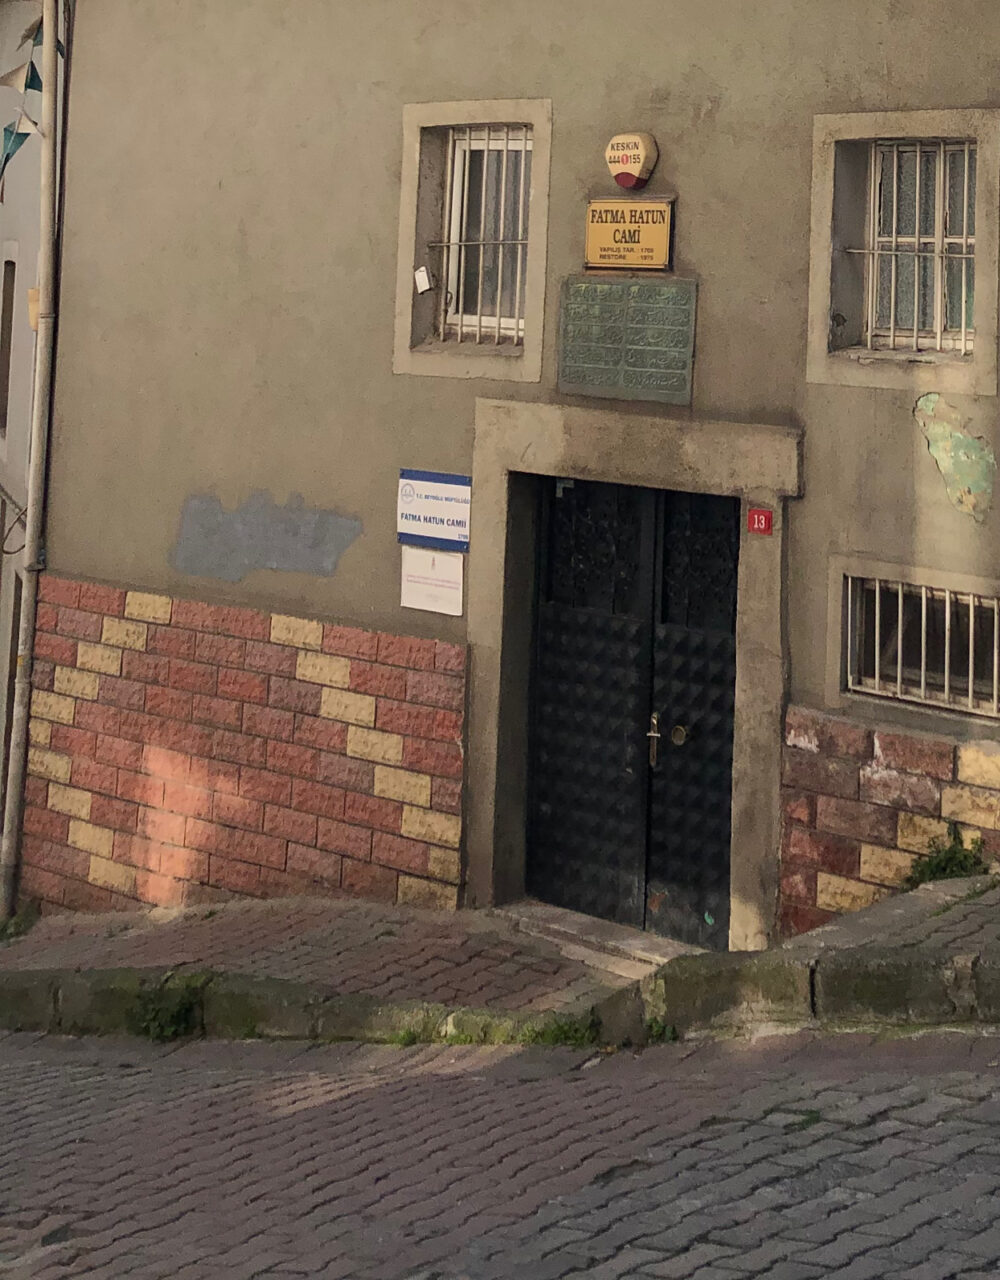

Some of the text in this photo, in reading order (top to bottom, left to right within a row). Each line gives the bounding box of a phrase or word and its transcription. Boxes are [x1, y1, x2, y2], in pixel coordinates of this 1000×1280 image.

[590, 209, 667, 225] FATMA HATUN
[613, 225, 641, 244] CAMİ
[401, 512, 421, 523] FATMA
[423, 515, 445, 525] HATUN
[753, 514, 766, 529] 13
